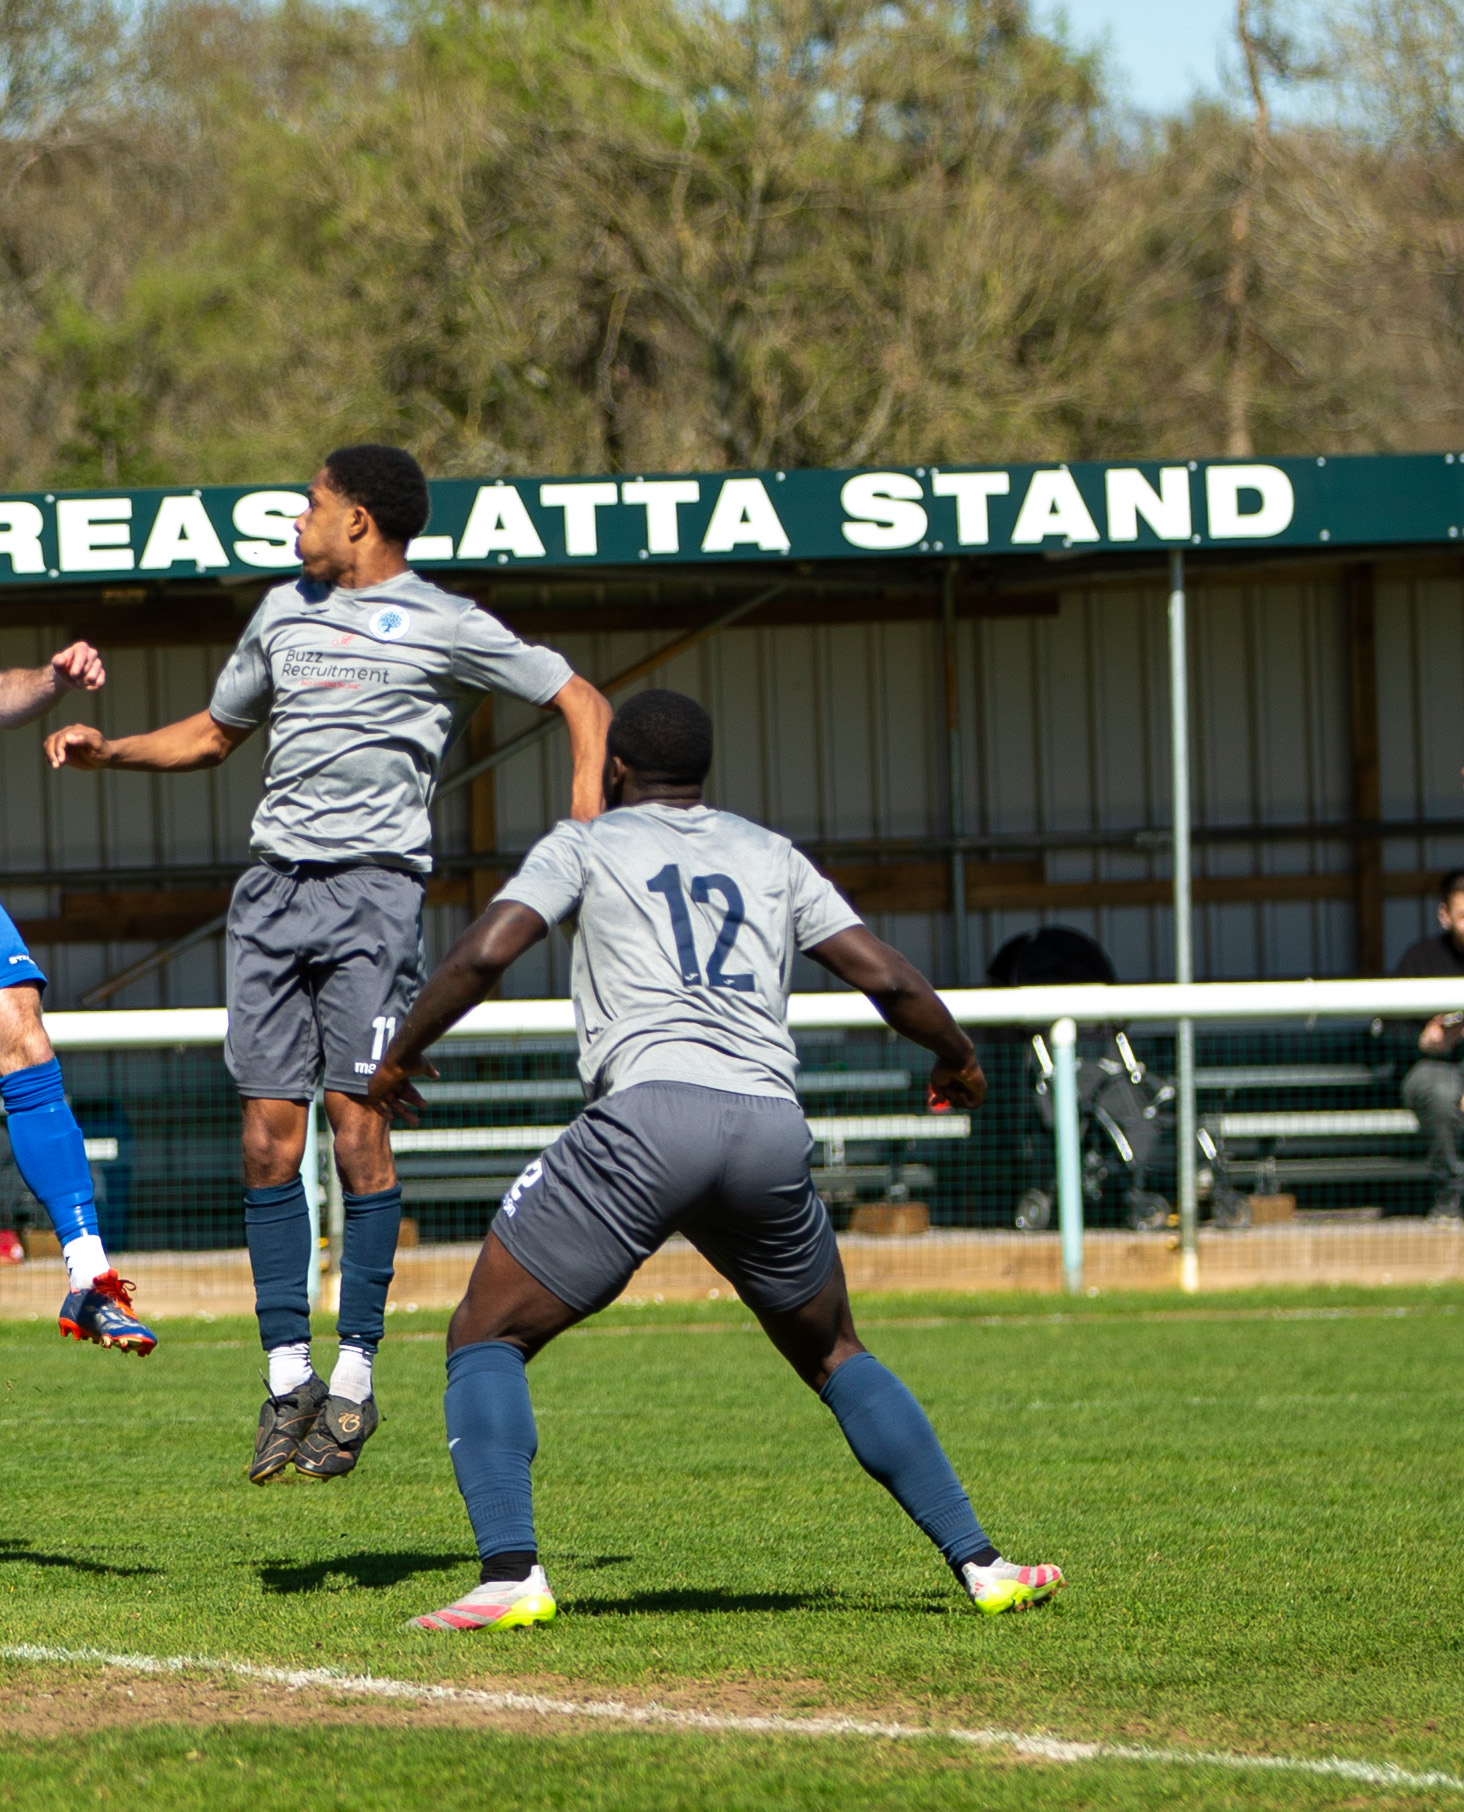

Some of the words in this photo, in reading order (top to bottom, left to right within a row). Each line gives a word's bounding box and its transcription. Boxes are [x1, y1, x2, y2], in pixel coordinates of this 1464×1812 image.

[841, 463, 1295, 550] STAND
[281, 663, 390, 684] Recruitment
[285, 649, 324, 663] Buzz
[646, 863, 756, 993] 12
[371, 1016, 396, 1061] 11
[511, 1158, 543, 1201] 2
